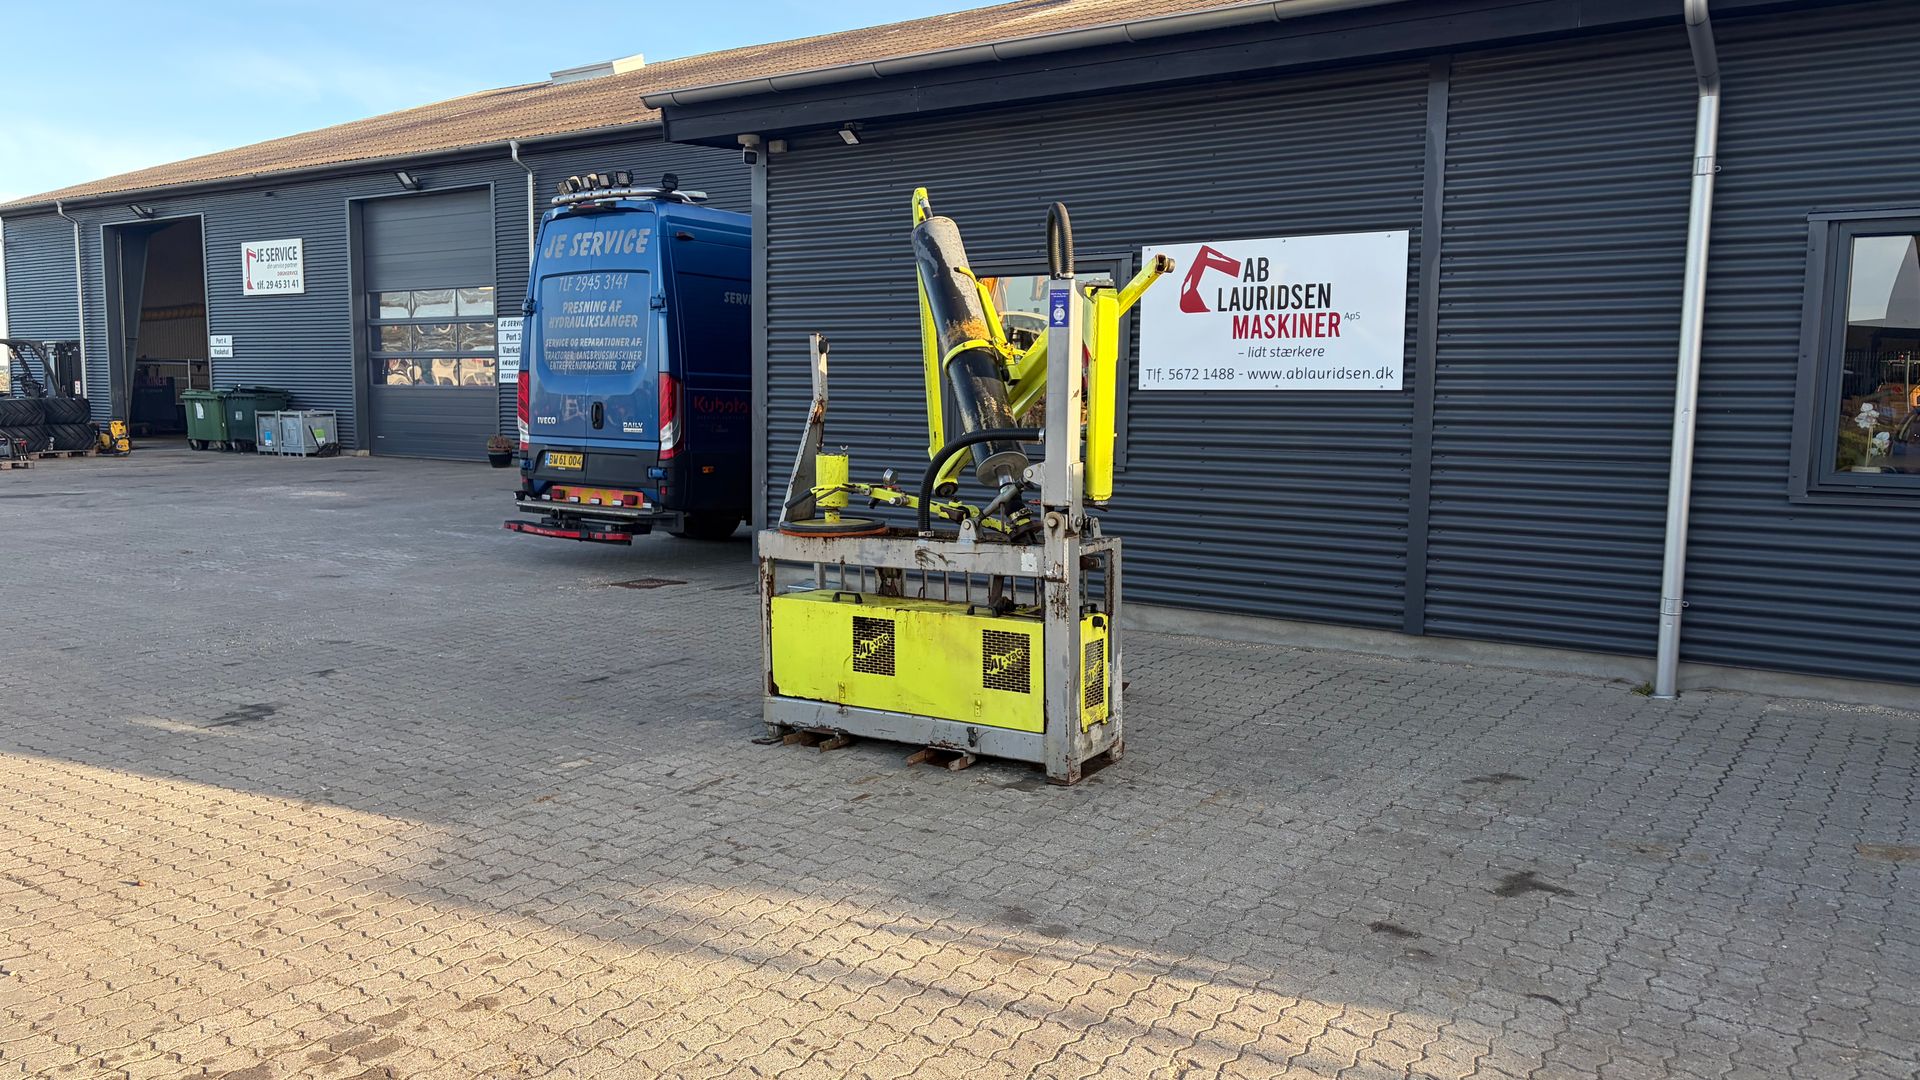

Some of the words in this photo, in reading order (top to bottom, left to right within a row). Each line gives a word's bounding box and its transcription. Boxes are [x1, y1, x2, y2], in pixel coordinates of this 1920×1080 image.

[544, 233, 568, 259] JE
[568, 228, 651, 256] SERVICE
[256, 248, 265, 263] JE
[265, 246, 298, 262] SERVICE
[1242, 257, 1270, 283] AB
[266, 280, 274, 290] 29
[274, 280, 283, 290] 45
[283, 279, 291, 289] 31
[291, 279, 300, 289] 41
[559, 277, 573, 292] TLF
[575, 274, 600, 293] 2945
[603, 273, 629, 290] 3141
[1217, 282, 1332, 313] LAURIDSEN
[562, 301, 607, 314] PRESNING
[608, 300, 622, 313] AF
[500, 321, 507, 329] JE
[548, 314, 639, 329] HYDRAULIKSLANGER
[1232, 311, 1341, 340] MASKINER
[1344, 312, 1361, 321] ApS
[506, 333, 516, 341] Port
[517, 332, 521, 340] 3
[1247, 347, 1266, 358] lidt
[1269, 346, 1325, 358] stærkere
[1145, 369, 1165, 382] Tlf.
[1168, 368, 1199, 380] 5672
[1203, 368, 1235, 380] 1488
[1247, 367, 1394, 380] www.ablauridsen.dk
[693, 395, 748, 414] Kubota
[537, 416, 557, 425] IVECO
[559, 455, 567, 465] 61
[568, 456, 582, 466] 004
